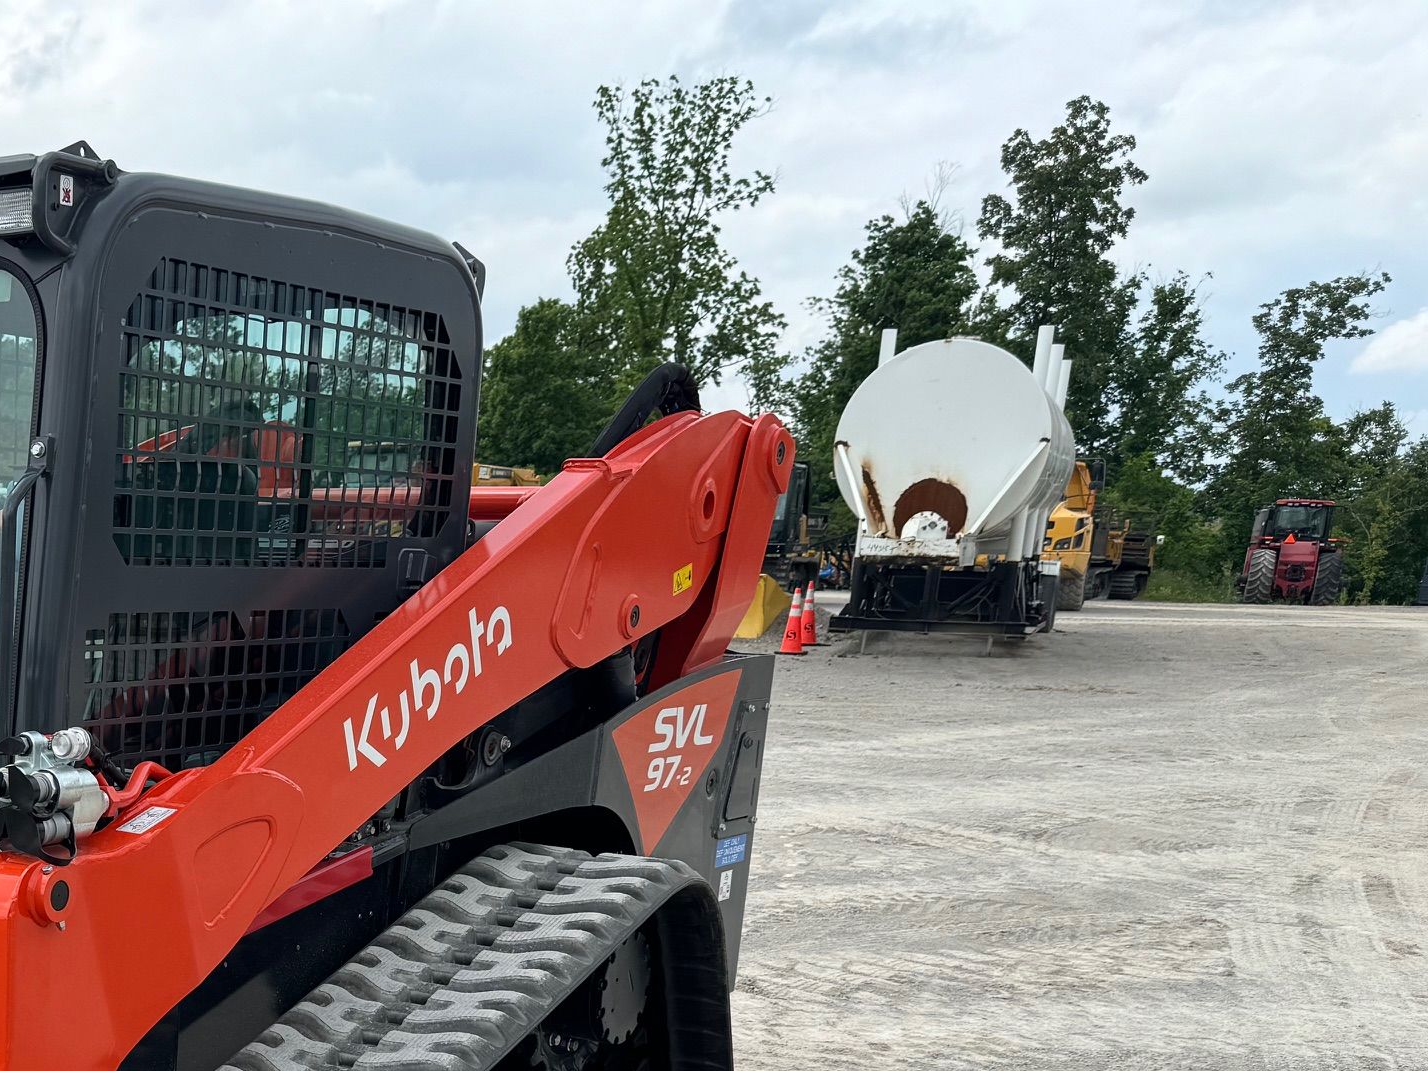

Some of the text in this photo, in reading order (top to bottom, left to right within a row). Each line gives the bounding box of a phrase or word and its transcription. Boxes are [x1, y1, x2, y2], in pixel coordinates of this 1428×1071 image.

[343, 606, 512, 771] Kubota
[648, 704, 713, 753] SVL
[644, 755, 691, 792] 97-2
